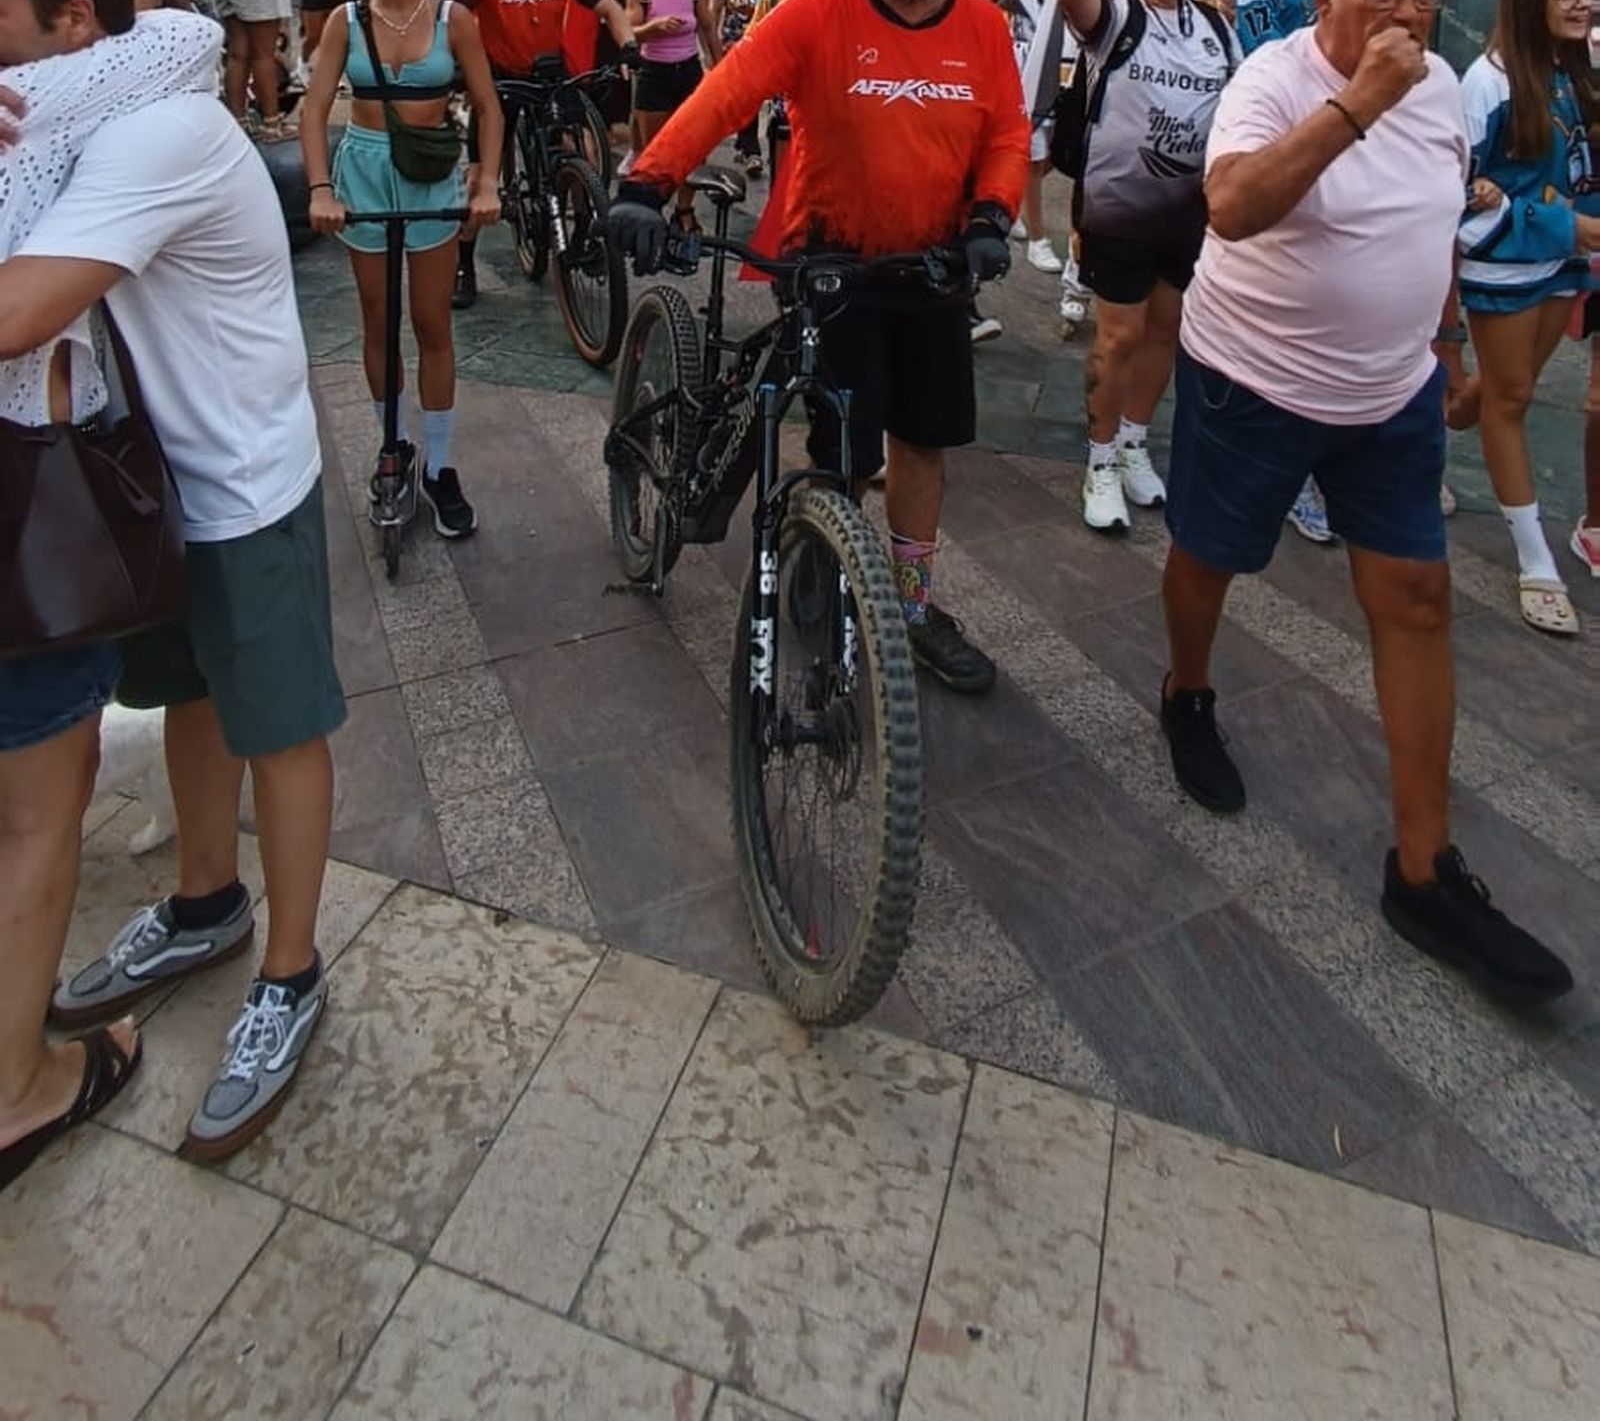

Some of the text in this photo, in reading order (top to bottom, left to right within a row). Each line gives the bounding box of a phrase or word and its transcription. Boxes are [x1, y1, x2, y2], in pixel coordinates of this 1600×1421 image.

[1243, 5, 1272, 38] 17
[759, 550, 778, 595] 36
[751, 616, 774, 695] FOX
